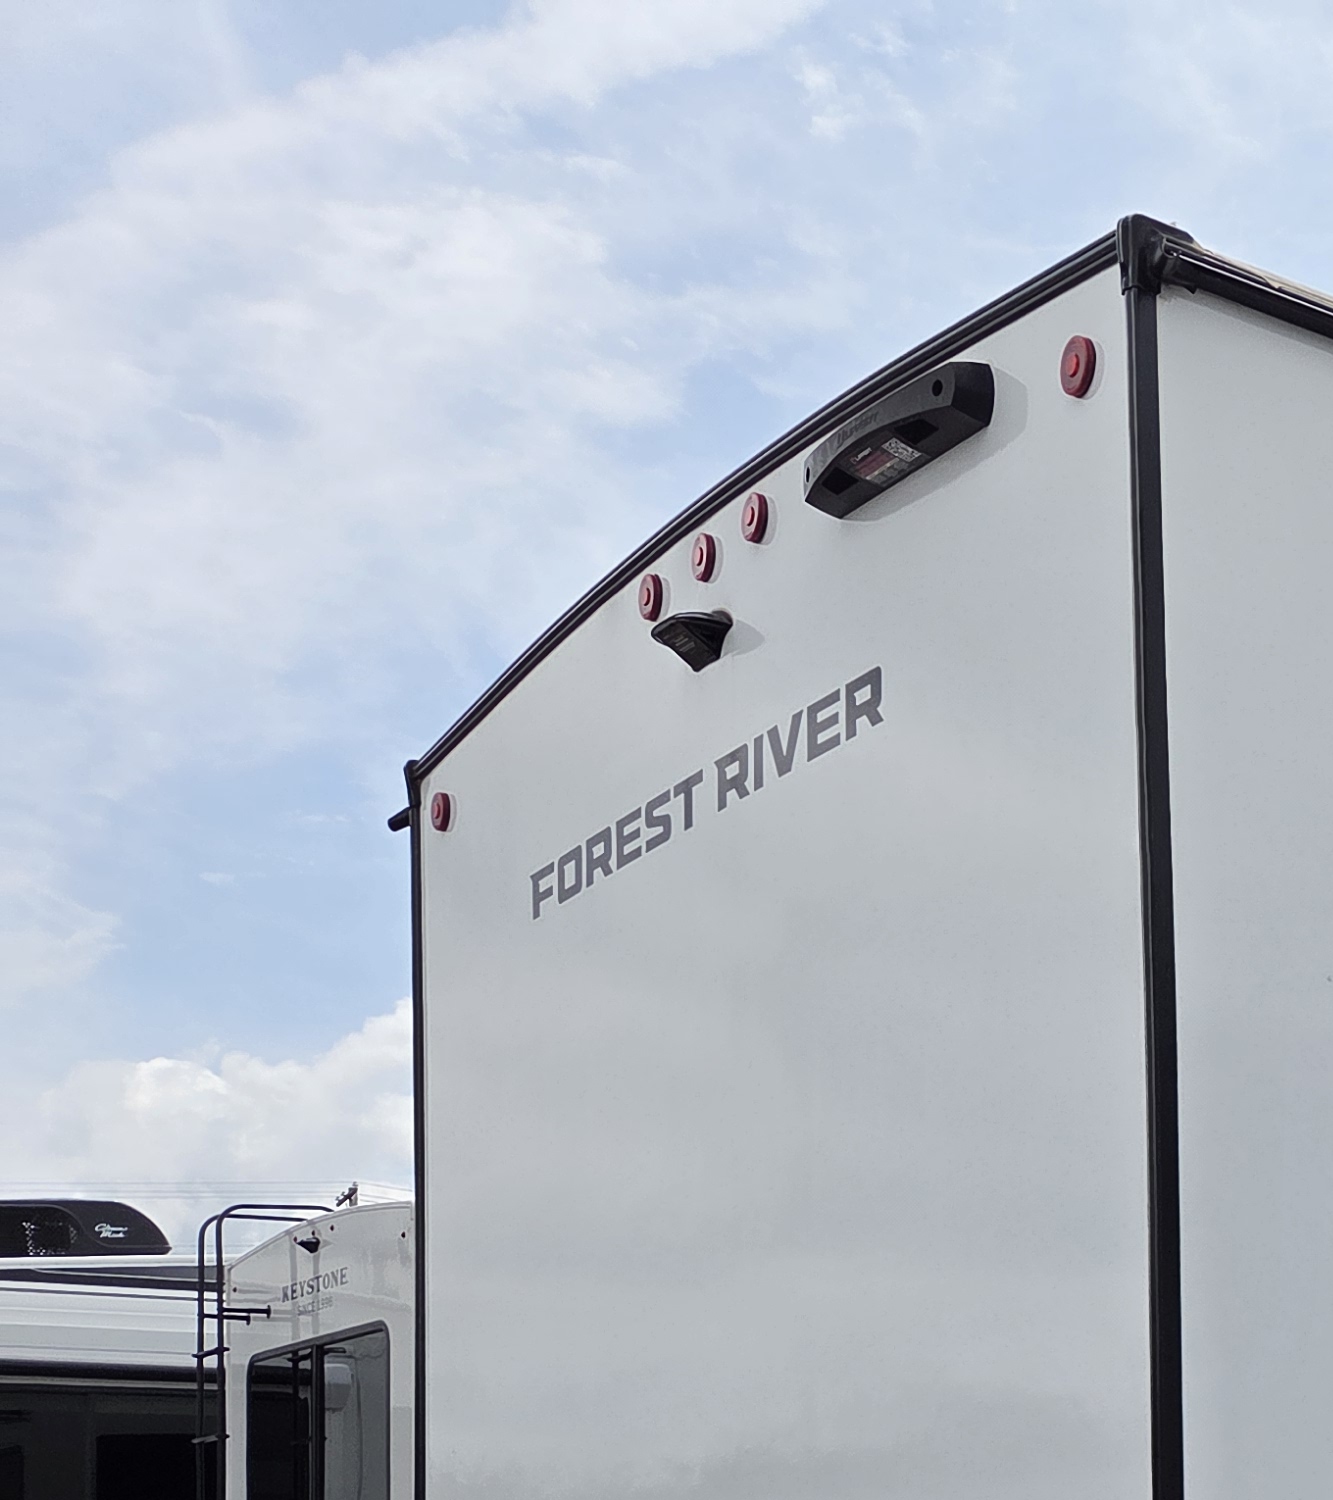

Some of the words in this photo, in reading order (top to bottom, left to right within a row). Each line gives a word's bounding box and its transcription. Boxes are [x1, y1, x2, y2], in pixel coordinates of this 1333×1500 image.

[530, 769, 703, 920] FOREST
[714, 666, 884, 812] RIVER
[281, 1267, 348, 1302] KEYSTONE
